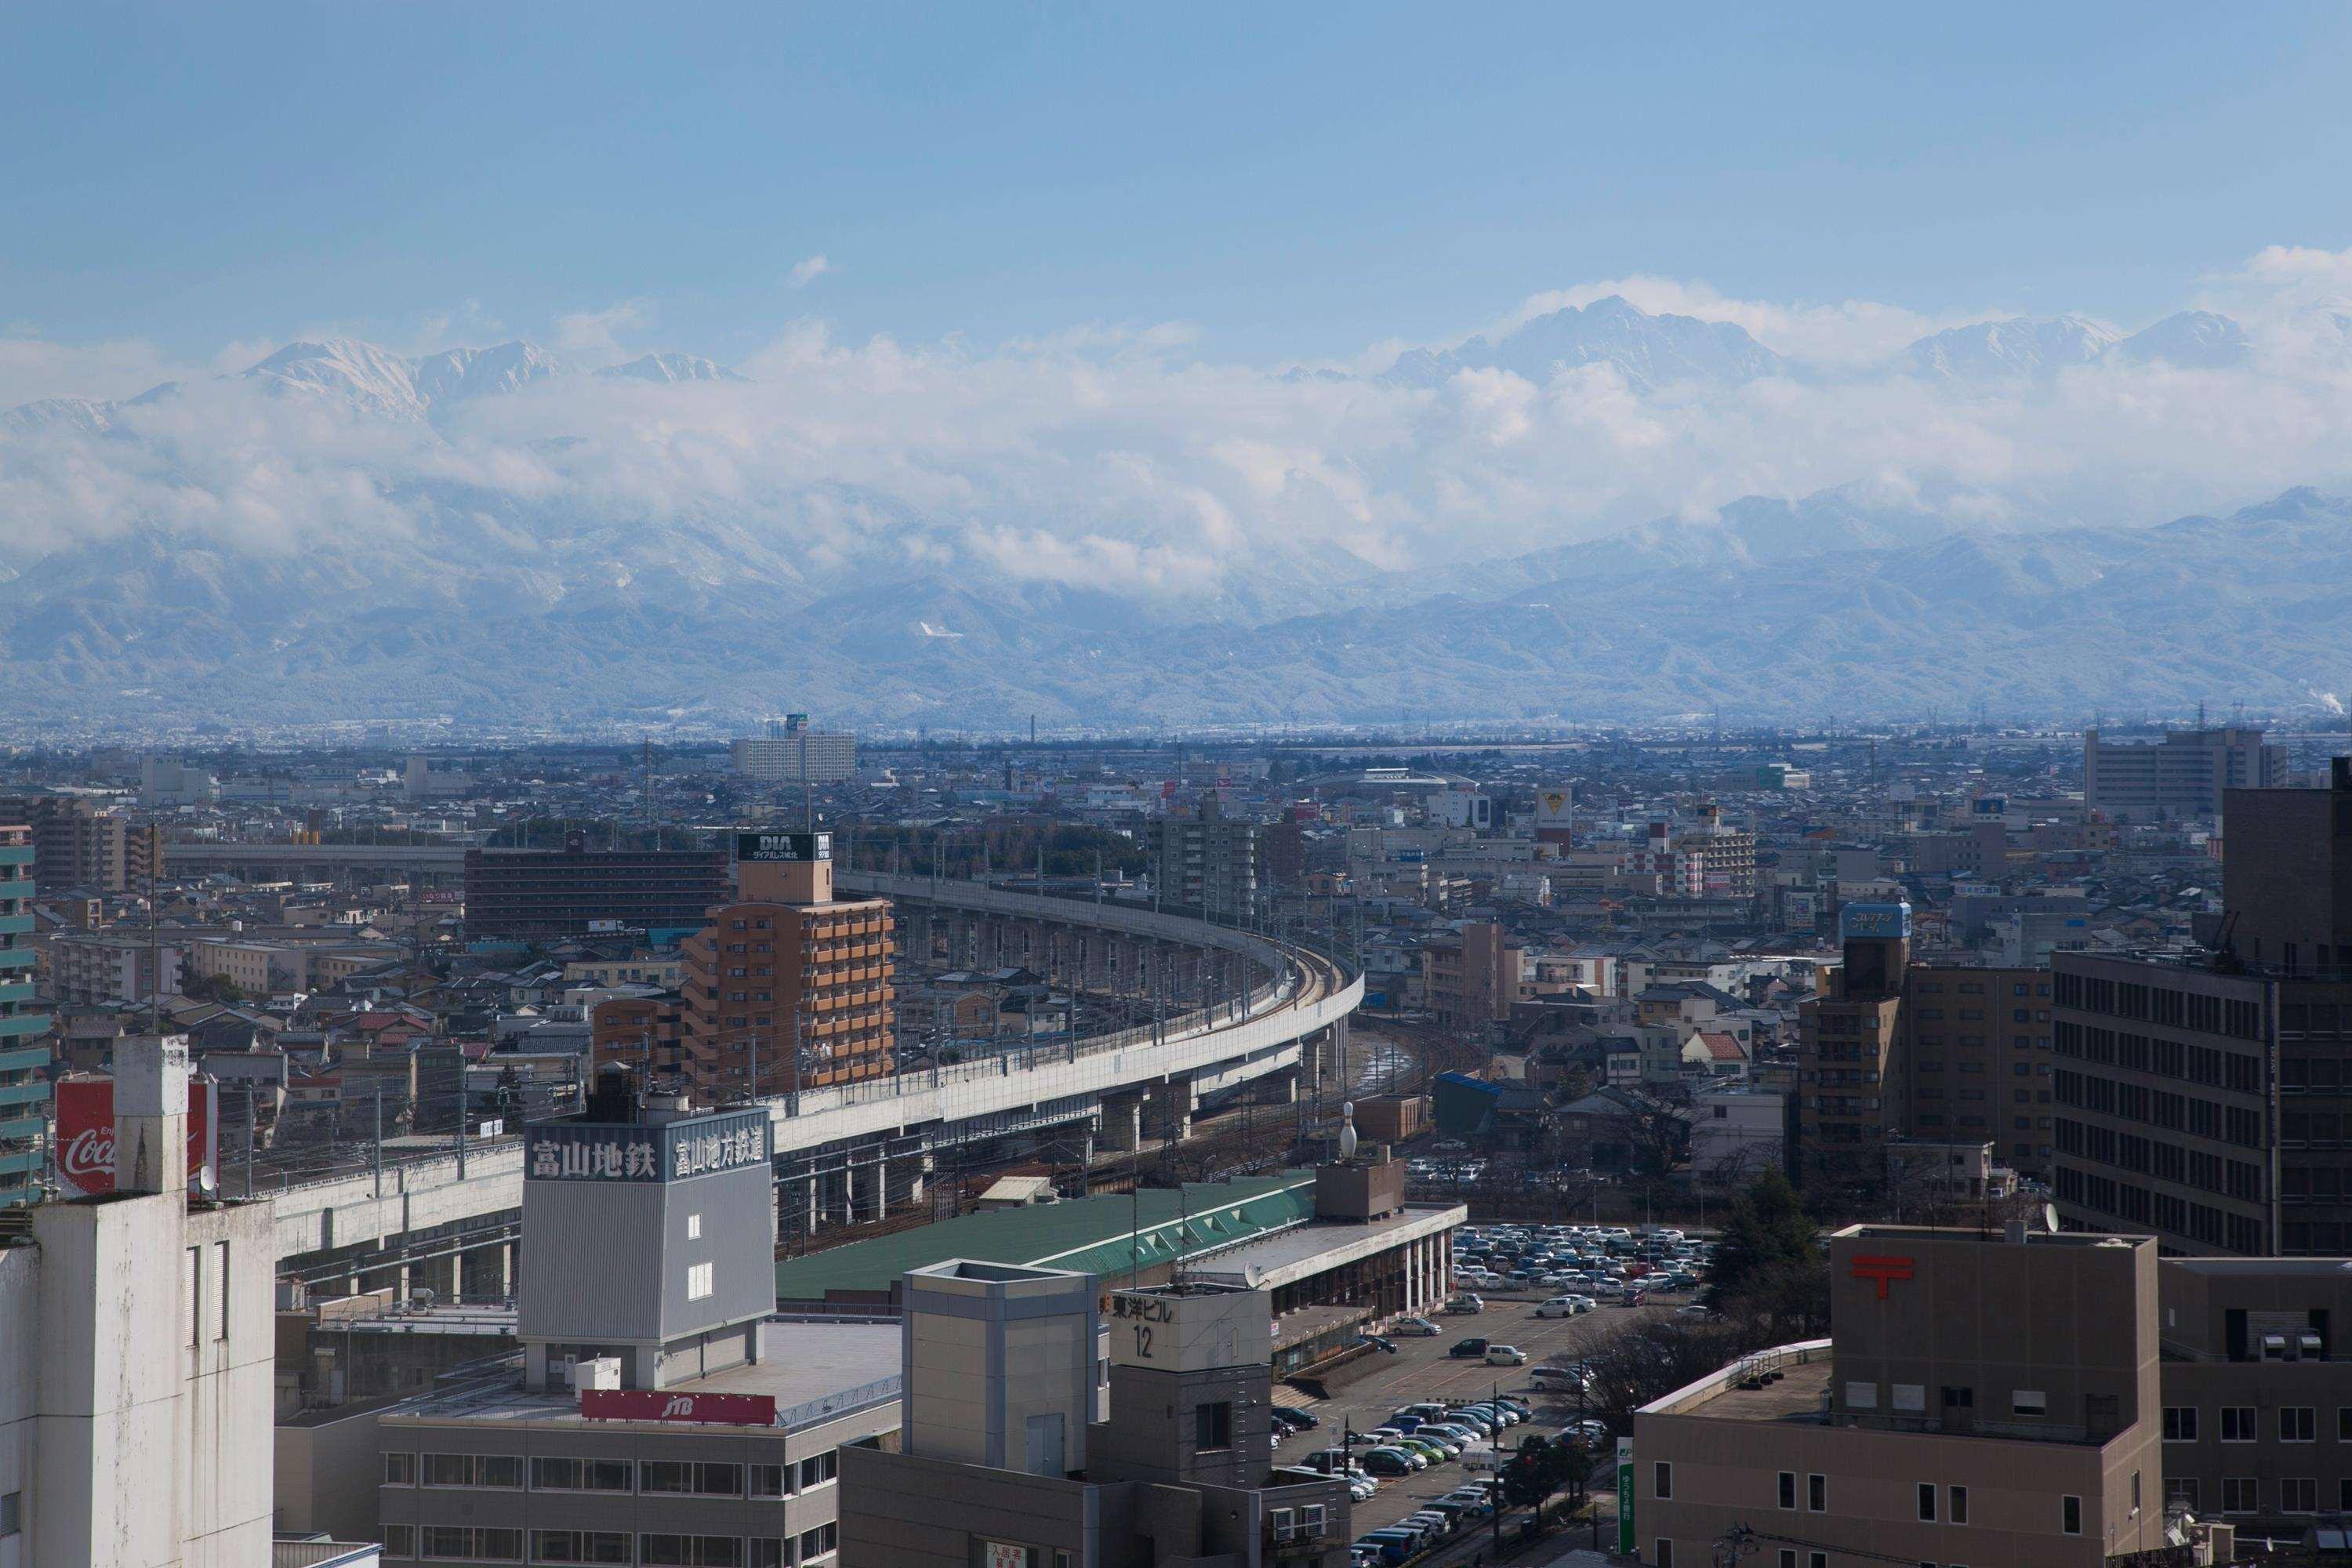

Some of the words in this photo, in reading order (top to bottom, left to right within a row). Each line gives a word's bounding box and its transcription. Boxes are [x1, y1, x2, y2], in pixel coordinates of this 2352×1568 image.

[760, 836, 792, 851] DIA
[532, 1139, 657, 1178] 富山地鉄
[674, 1126, 765, 1177] 富山地方鉄道
[1111, 1294, 1172, 1323] 東洋ビル
[1134, 1323, 1152, 1358] 12
[661, 1396, 695, 1417] JTB
[992, 1545, 1022, 1561] 入居者
